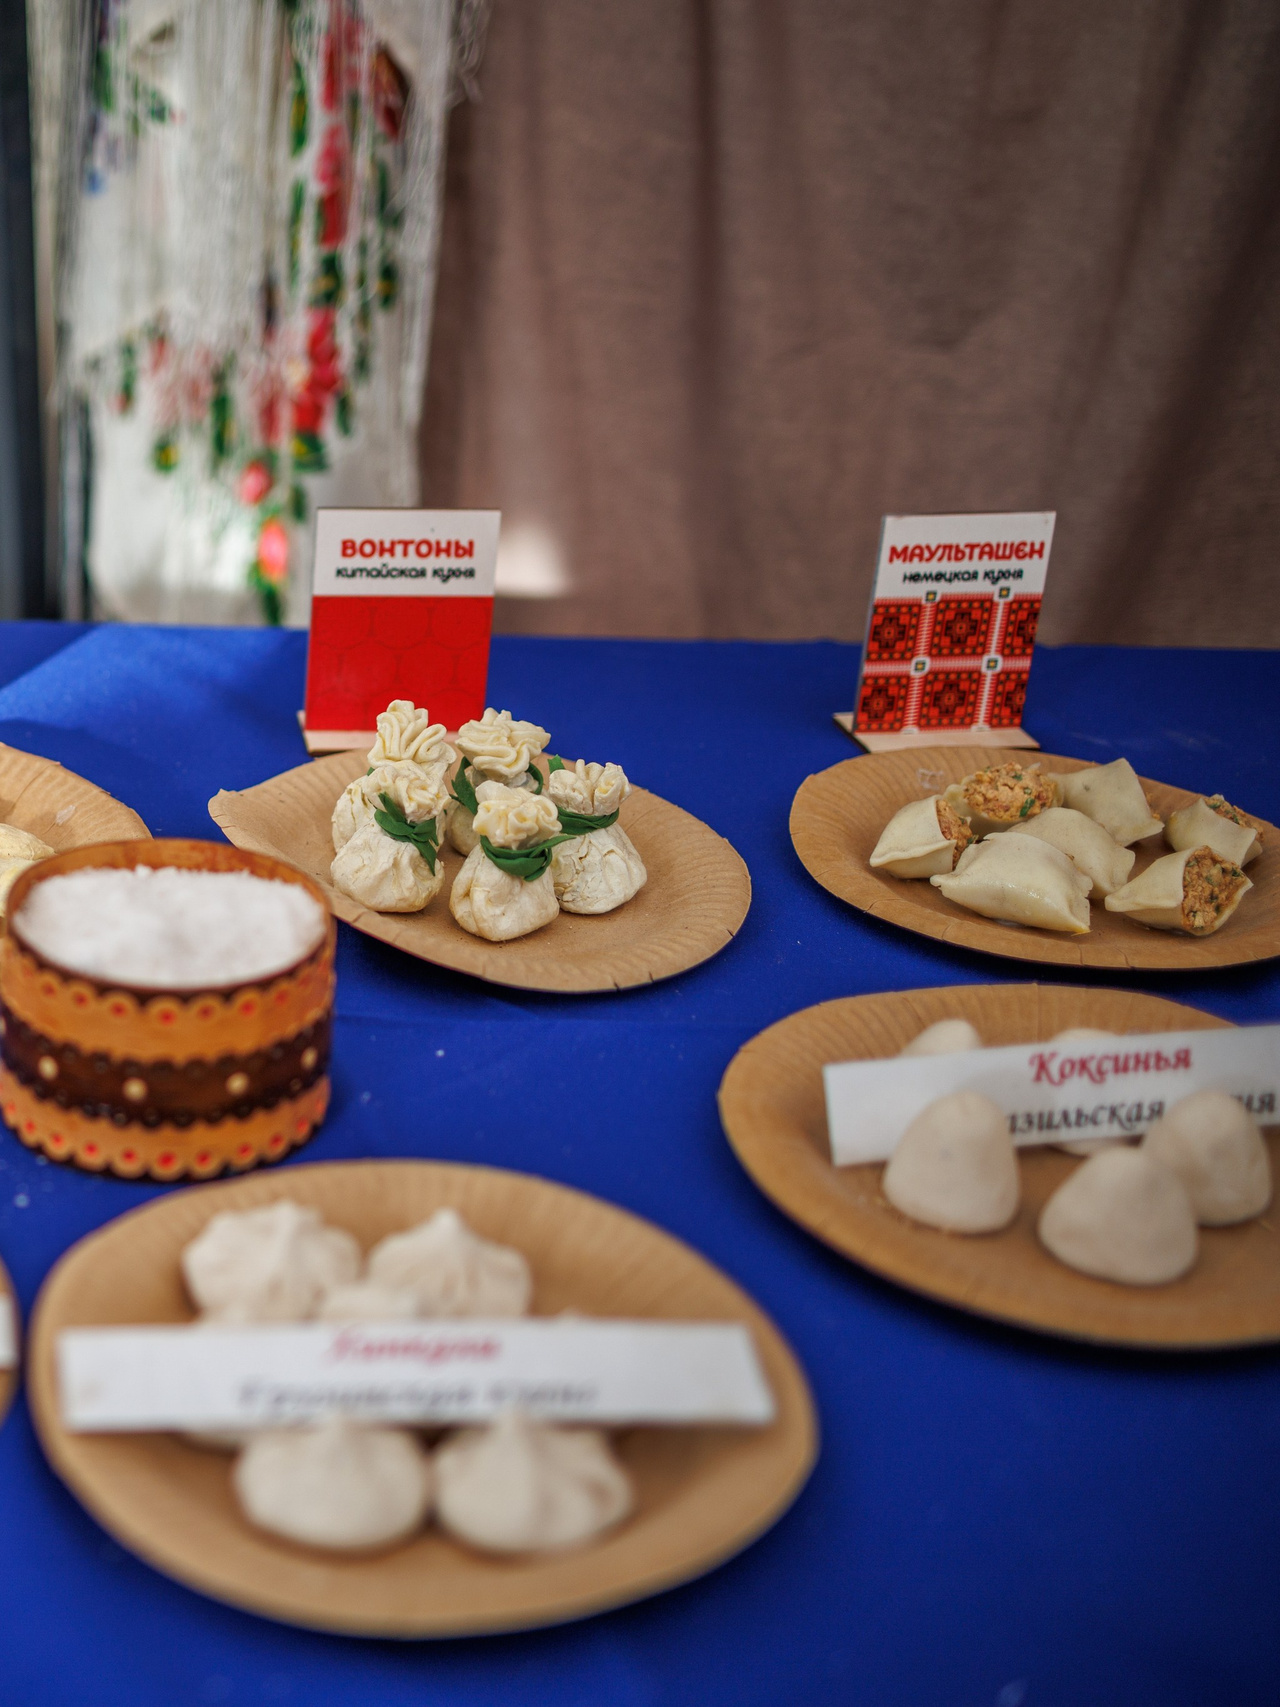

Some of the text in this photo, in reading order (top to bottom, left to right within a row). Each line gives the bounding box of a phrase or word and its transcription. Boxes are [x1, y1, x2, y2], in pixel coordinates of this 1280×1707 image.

[341, 539, 475, 559] ВОНТОНЫ
[888, 541, 1045, 564] МАУЛЬТАШЕН
[336, 563, 476, 584] китайская кухня
[903, 568, 1024, 585] немецкая кухня
[1028, 1047, 1192, 1086] Коксинья
